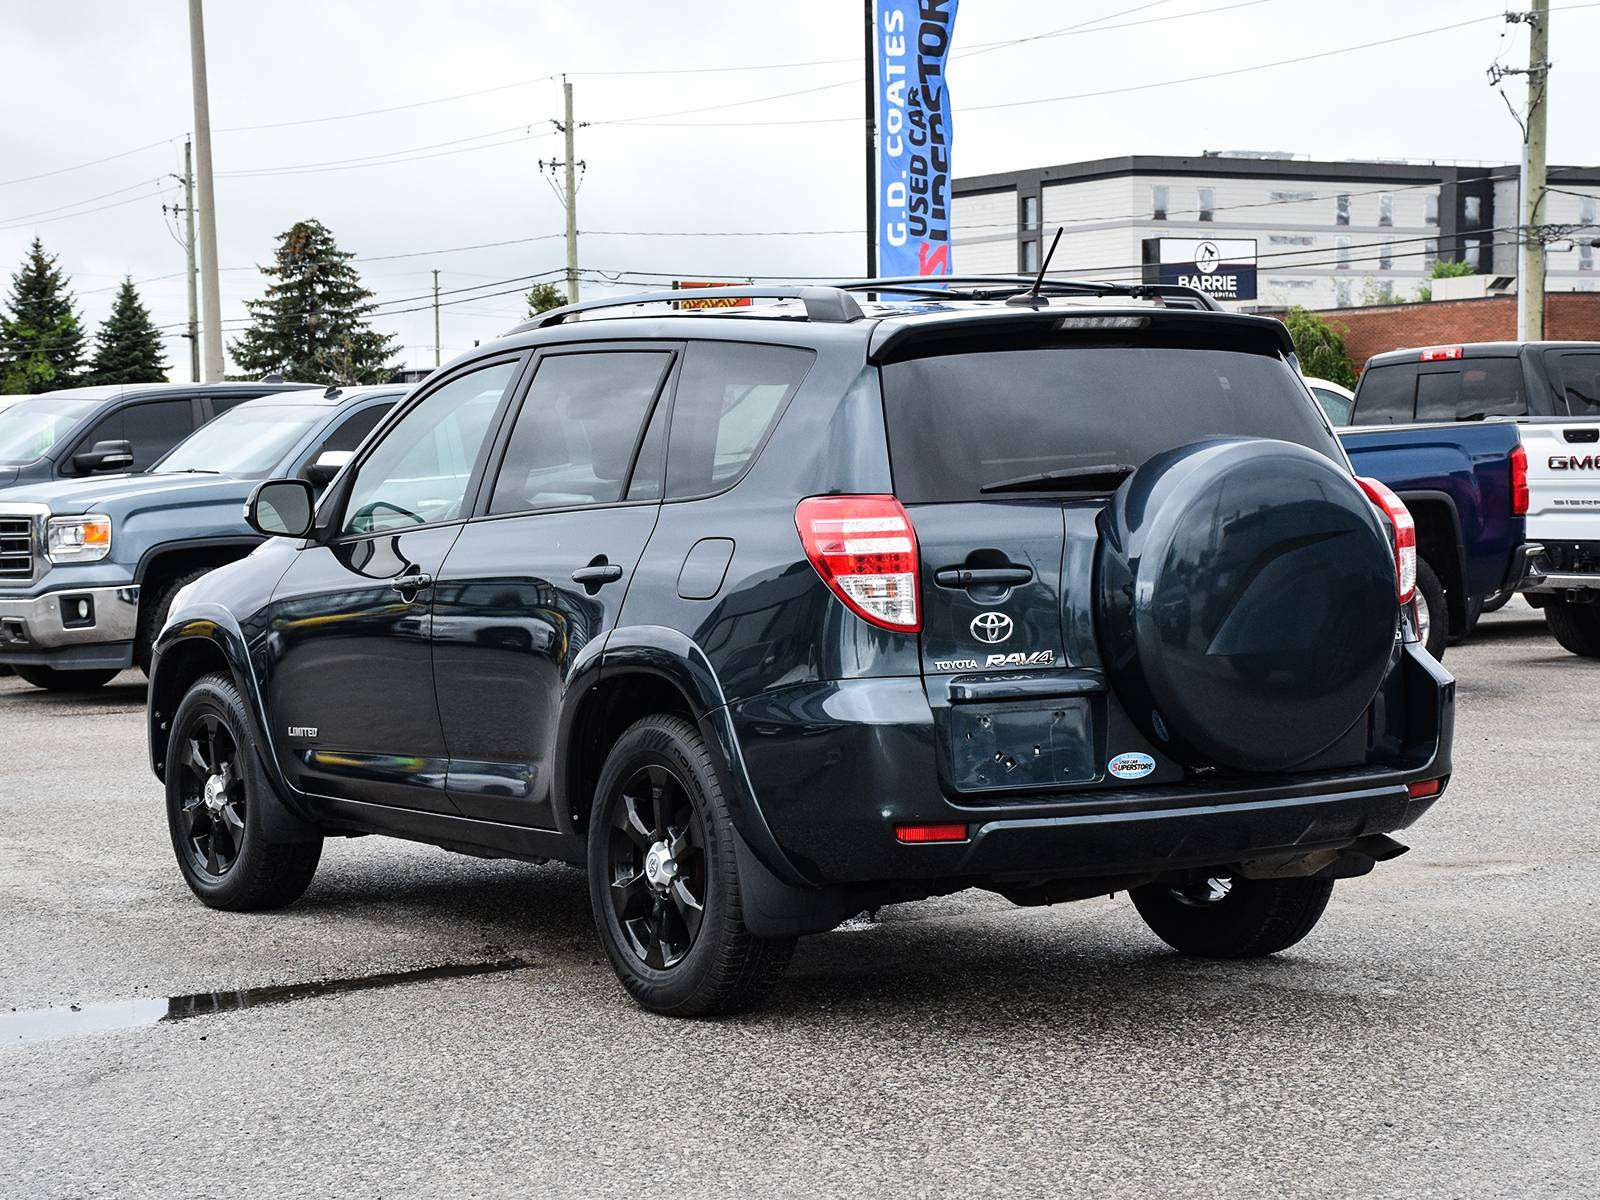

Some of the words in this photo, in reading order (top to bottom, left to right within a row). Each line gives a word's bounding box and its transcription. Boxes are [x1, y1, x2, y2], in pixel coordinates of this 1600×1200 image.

[885, 9, 906, 157] COATES
[908, 86, 927, 147] CAR
[909, 154, 928, 237] USED
[887, 170, 907, 247] G.D.
[1178, 275, 1237, 291] BARRIE
[1548, 455, 1600, 470] GM
[935, 660, 978, 670] TOYOTA
[985, 650, 1053, 667] RAV4
[288, 726, 318, 737] LIMITED
